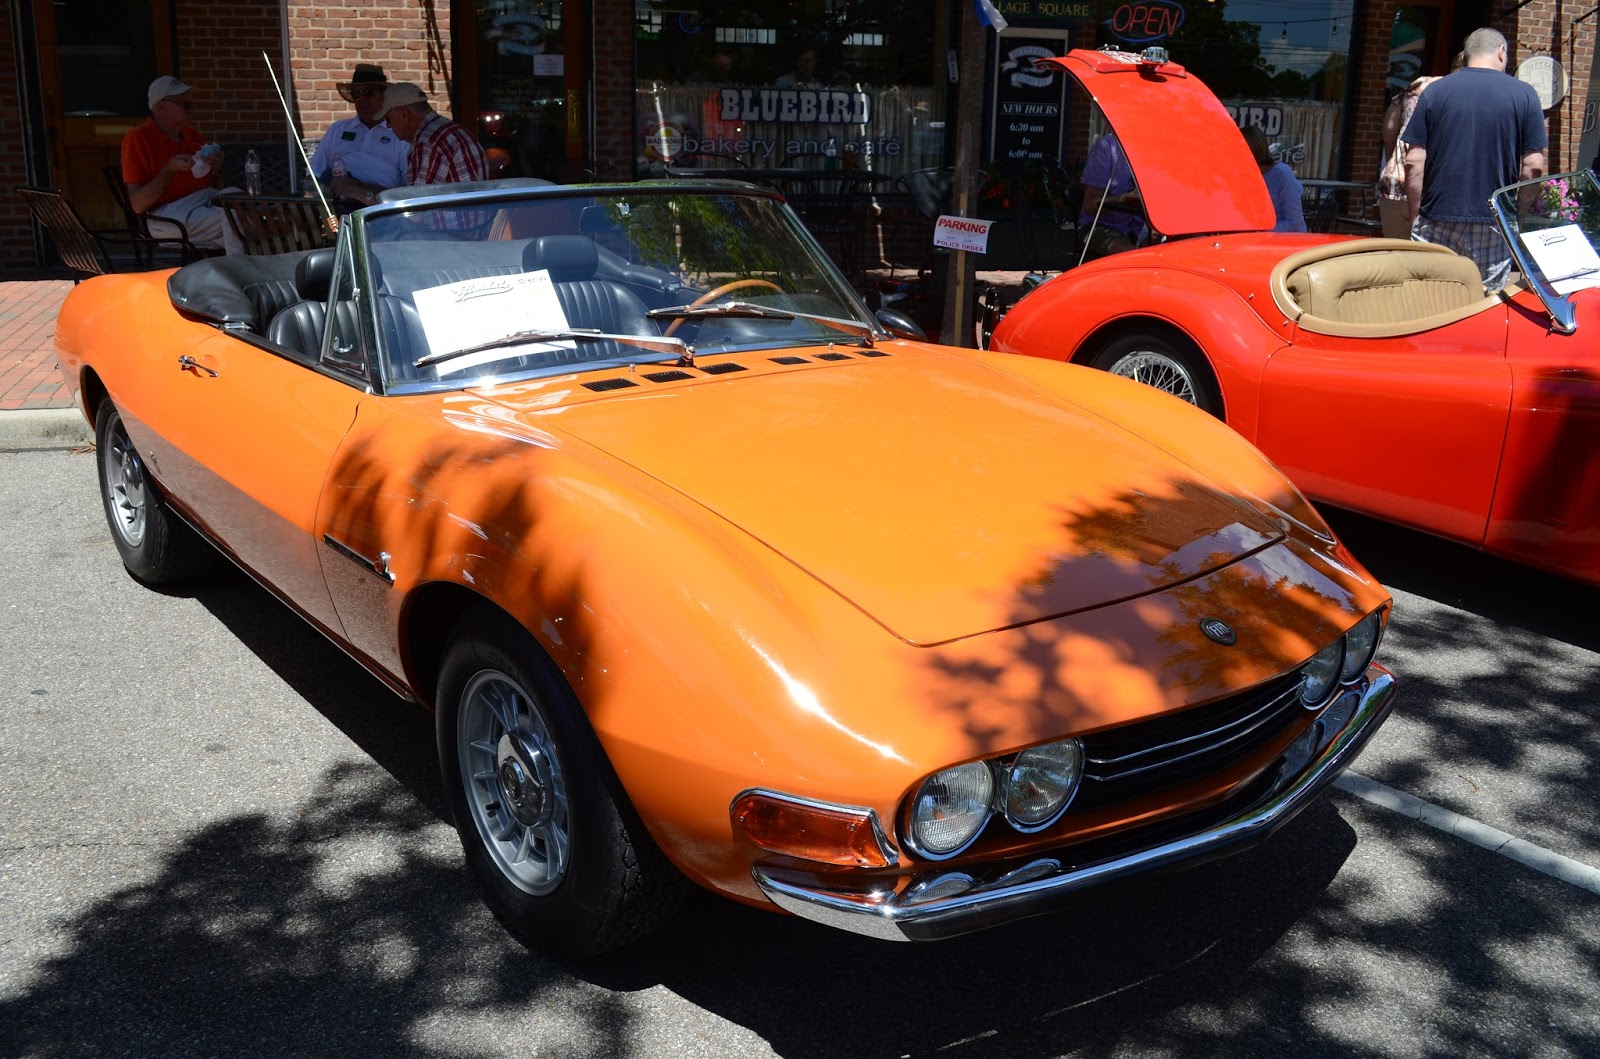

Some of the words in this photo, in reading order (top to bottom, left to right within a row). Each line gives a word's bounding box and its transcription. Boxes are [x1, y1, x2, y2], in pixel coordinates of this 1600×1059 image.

[1038, 3, 1090, 17] SQUARE
[1112, 3, 1180, 37] OPEN
[720, 89, 870, 124] BLUEBIRD
[1003, 104, 1022, 113] NEW
[1024, 104, 1057, 114] HOURS
[1009, 122, 1030, 132] 6:30
[683, 134, 777, 159] bakery
[847, 136, 901, 156] café
[938, 218, 987, 235] PARKING
[936, 239, 961, 248] POLICE
[961, 244, 984, 253] ORDER
